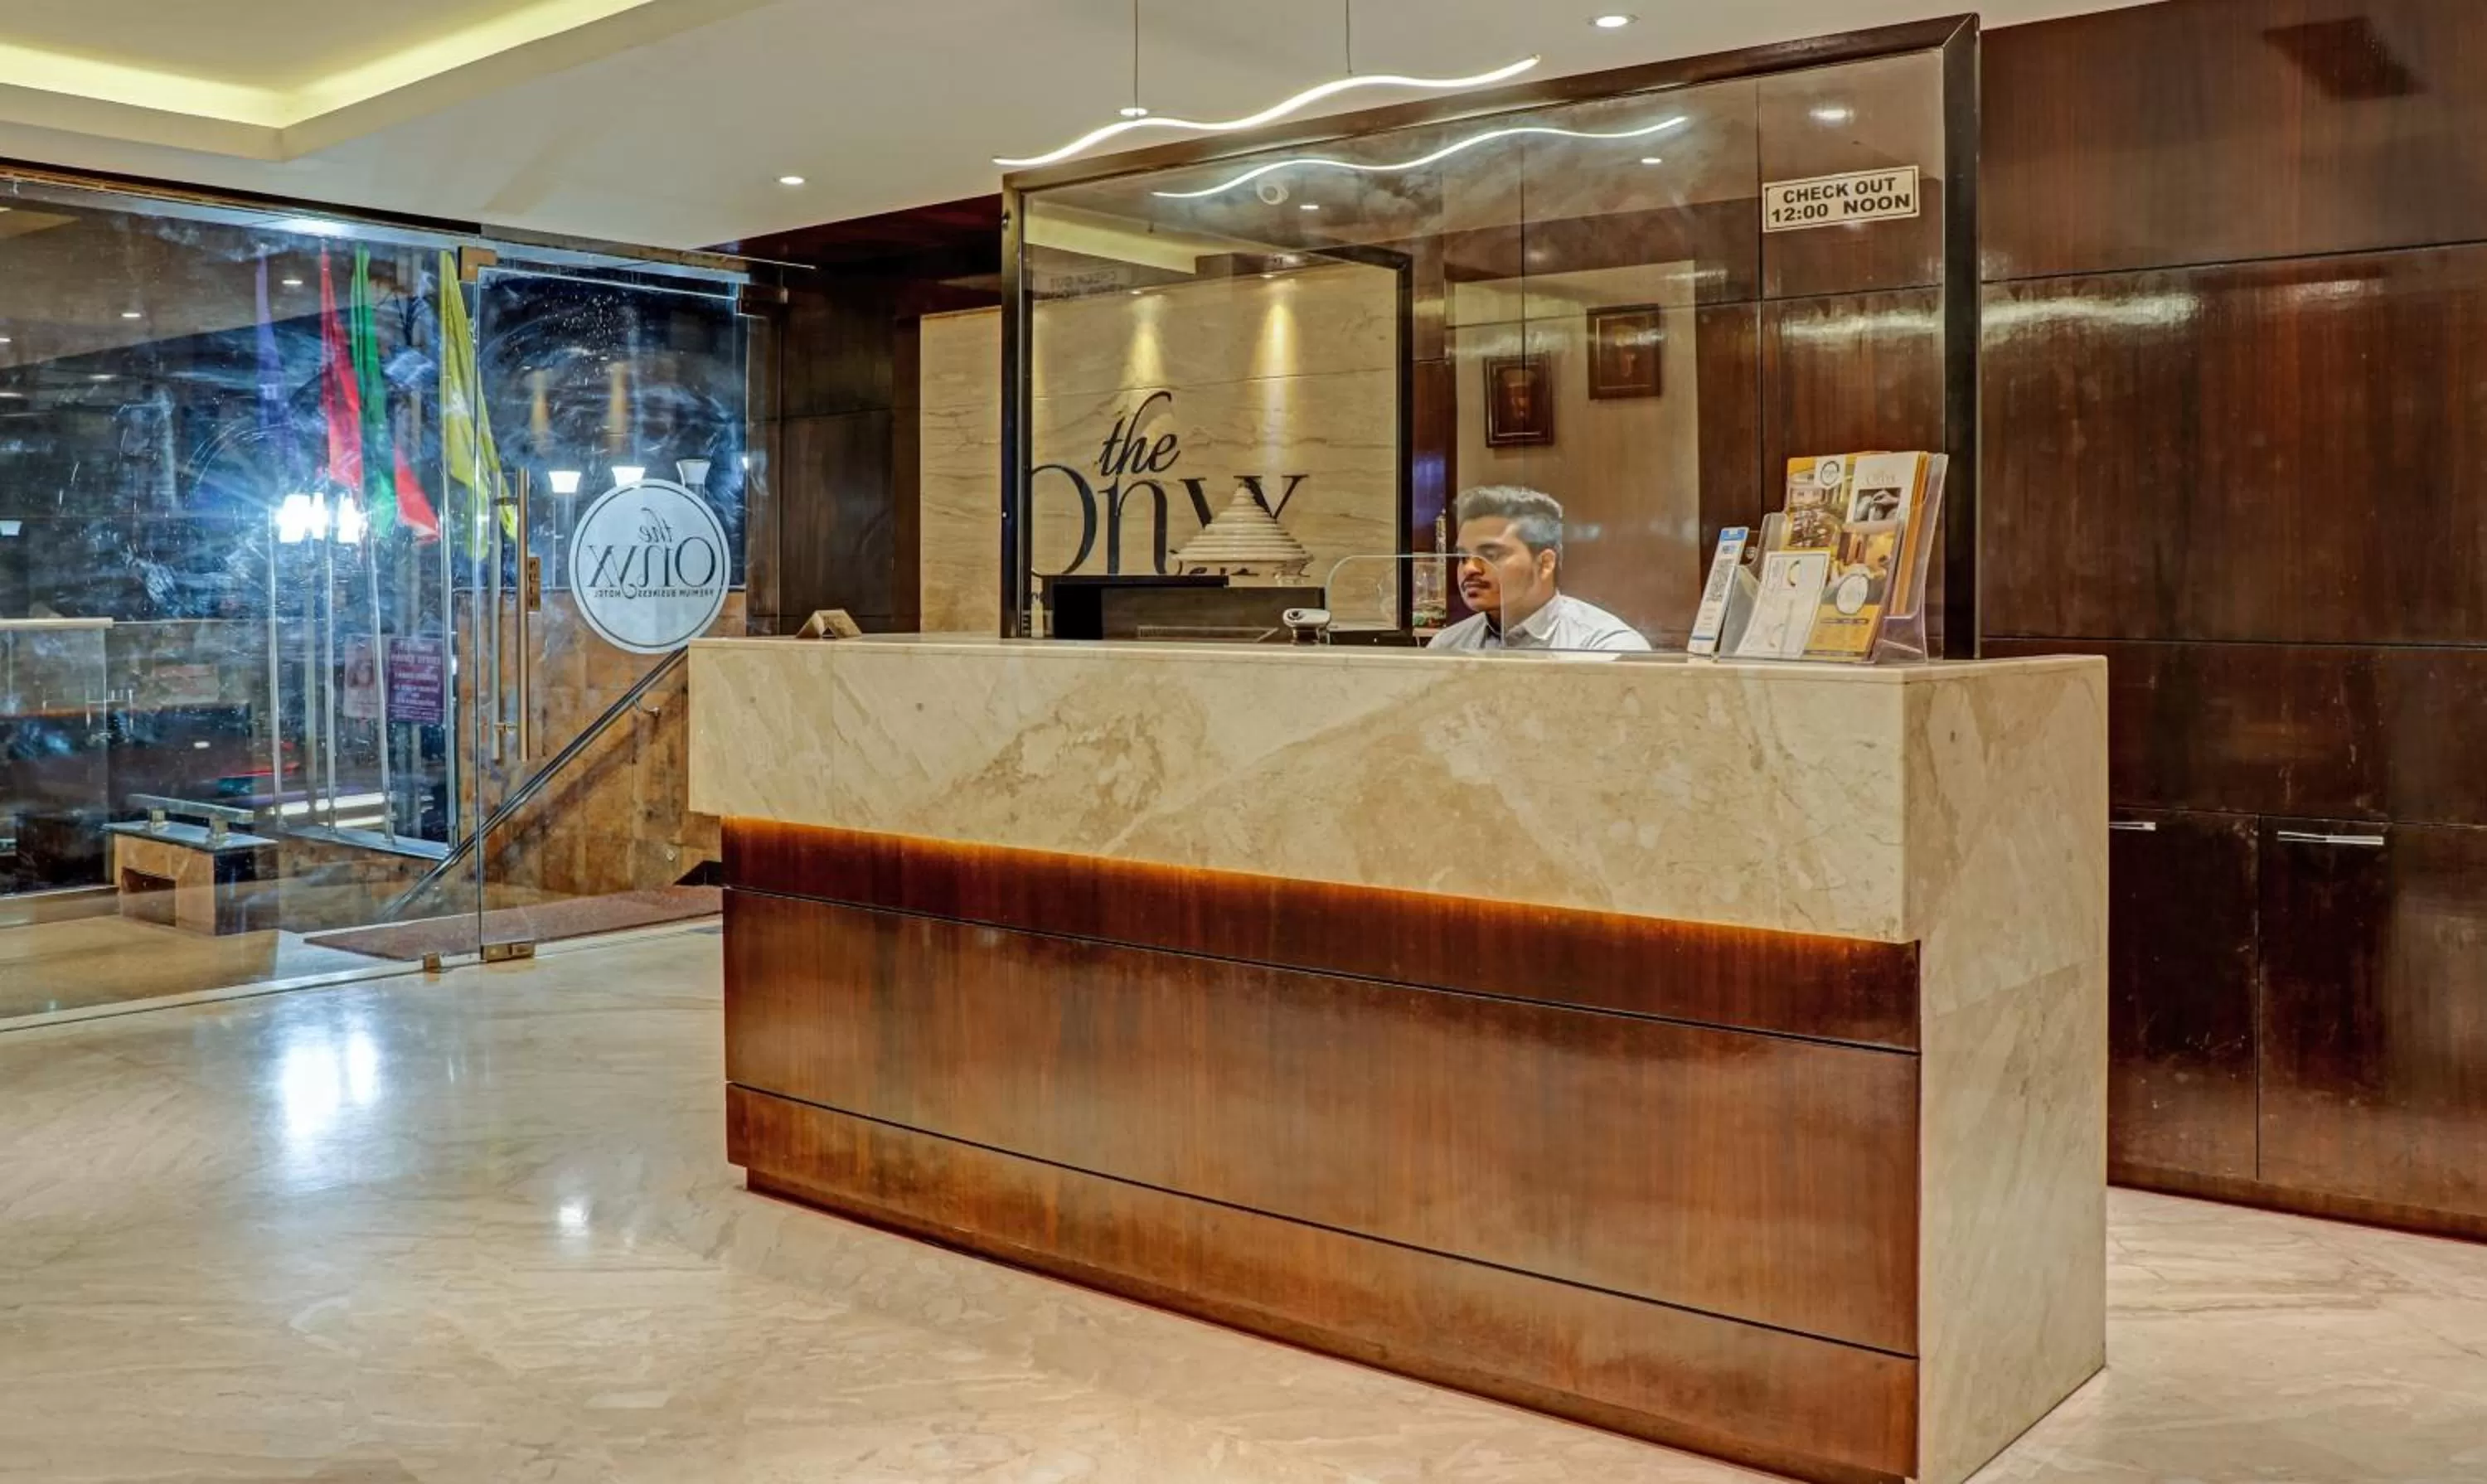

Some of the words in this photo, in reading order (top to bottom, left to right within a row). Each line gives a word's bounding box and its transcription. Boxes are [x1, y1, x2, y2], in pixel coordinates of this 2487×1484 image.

[1783, 183, 1849, 204] CHECK
[1854, 177, 1897, 195] OUT
[1772, 203, 1829, 223] 12:00
[1843, 193, 1910, 215] NOON
[1098, 391, 1180, 476] the
